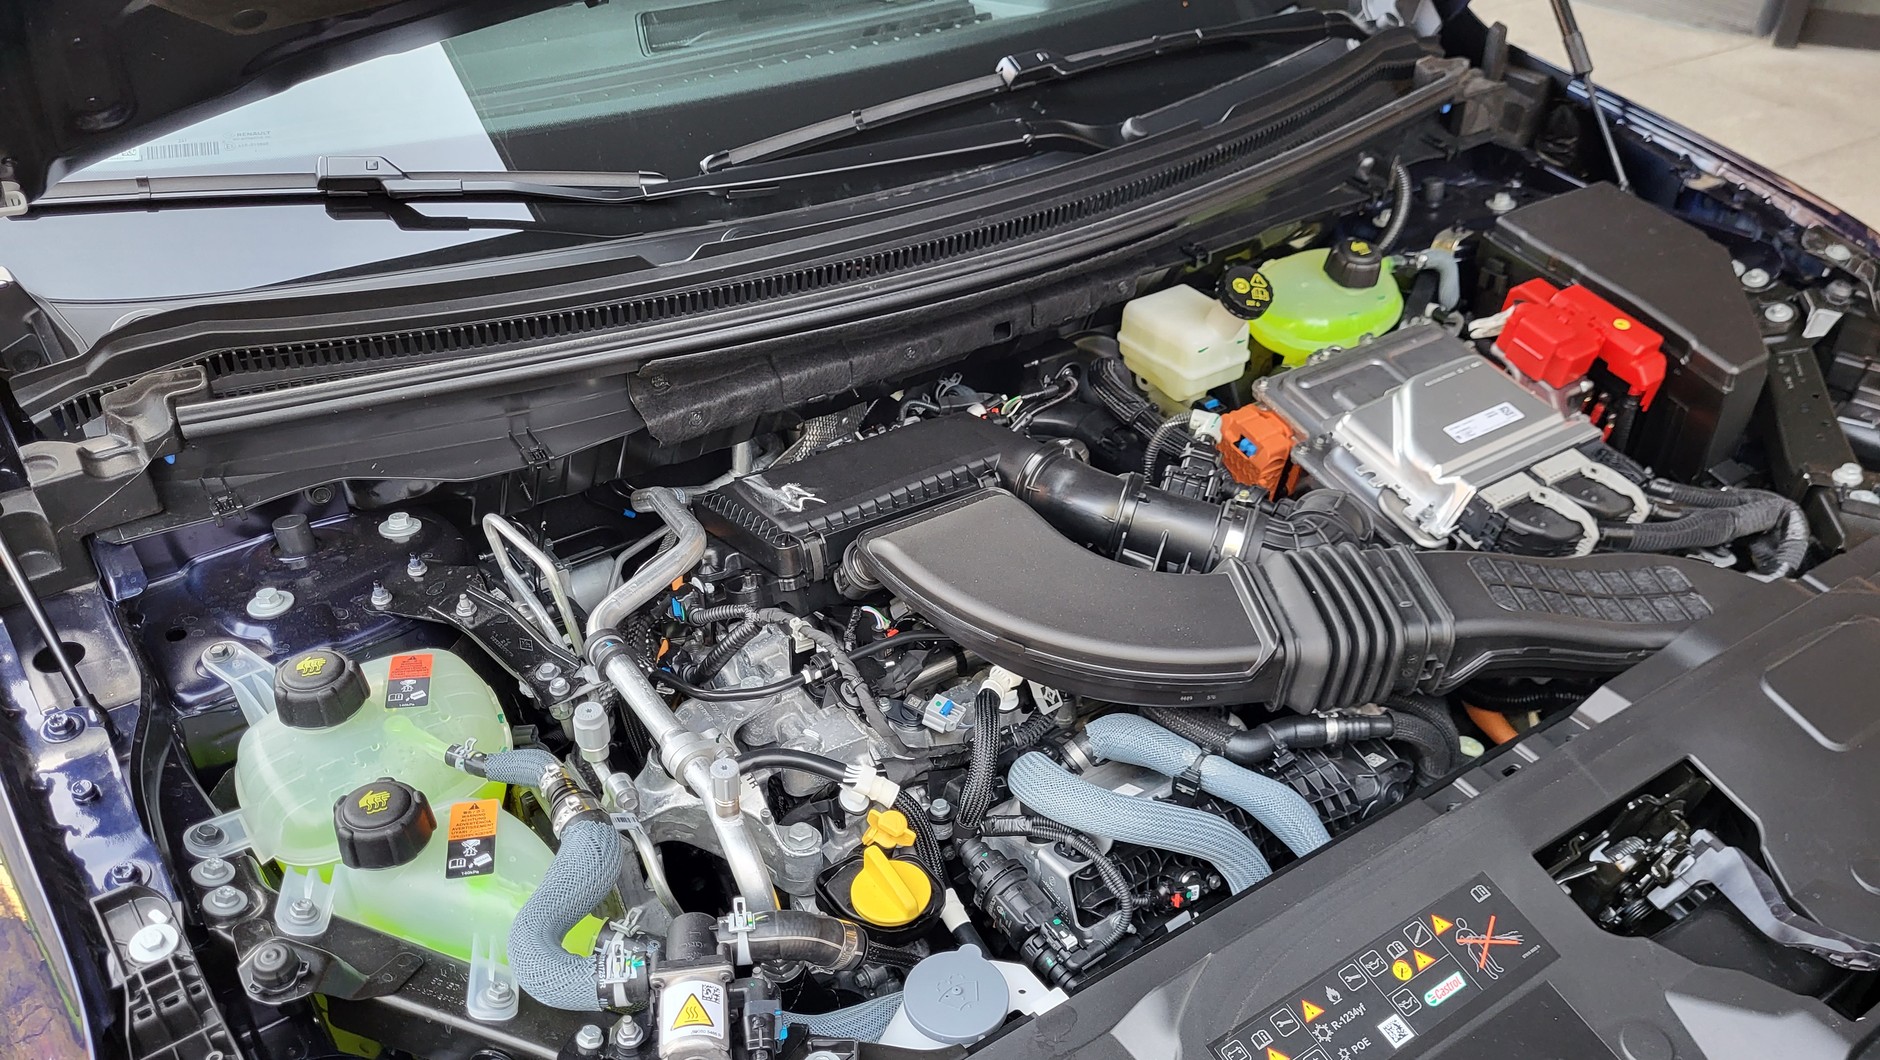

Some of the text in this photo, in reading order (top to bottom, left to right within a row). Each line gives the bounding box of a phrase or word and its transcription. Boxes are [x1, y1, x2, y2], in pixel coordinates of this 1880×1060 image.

[1434, 976, 1463, 1000] Castrol
[1330, 1002, 1367, 1031] R-1234yf
[1350, 1036, 1372, 1055] POE
